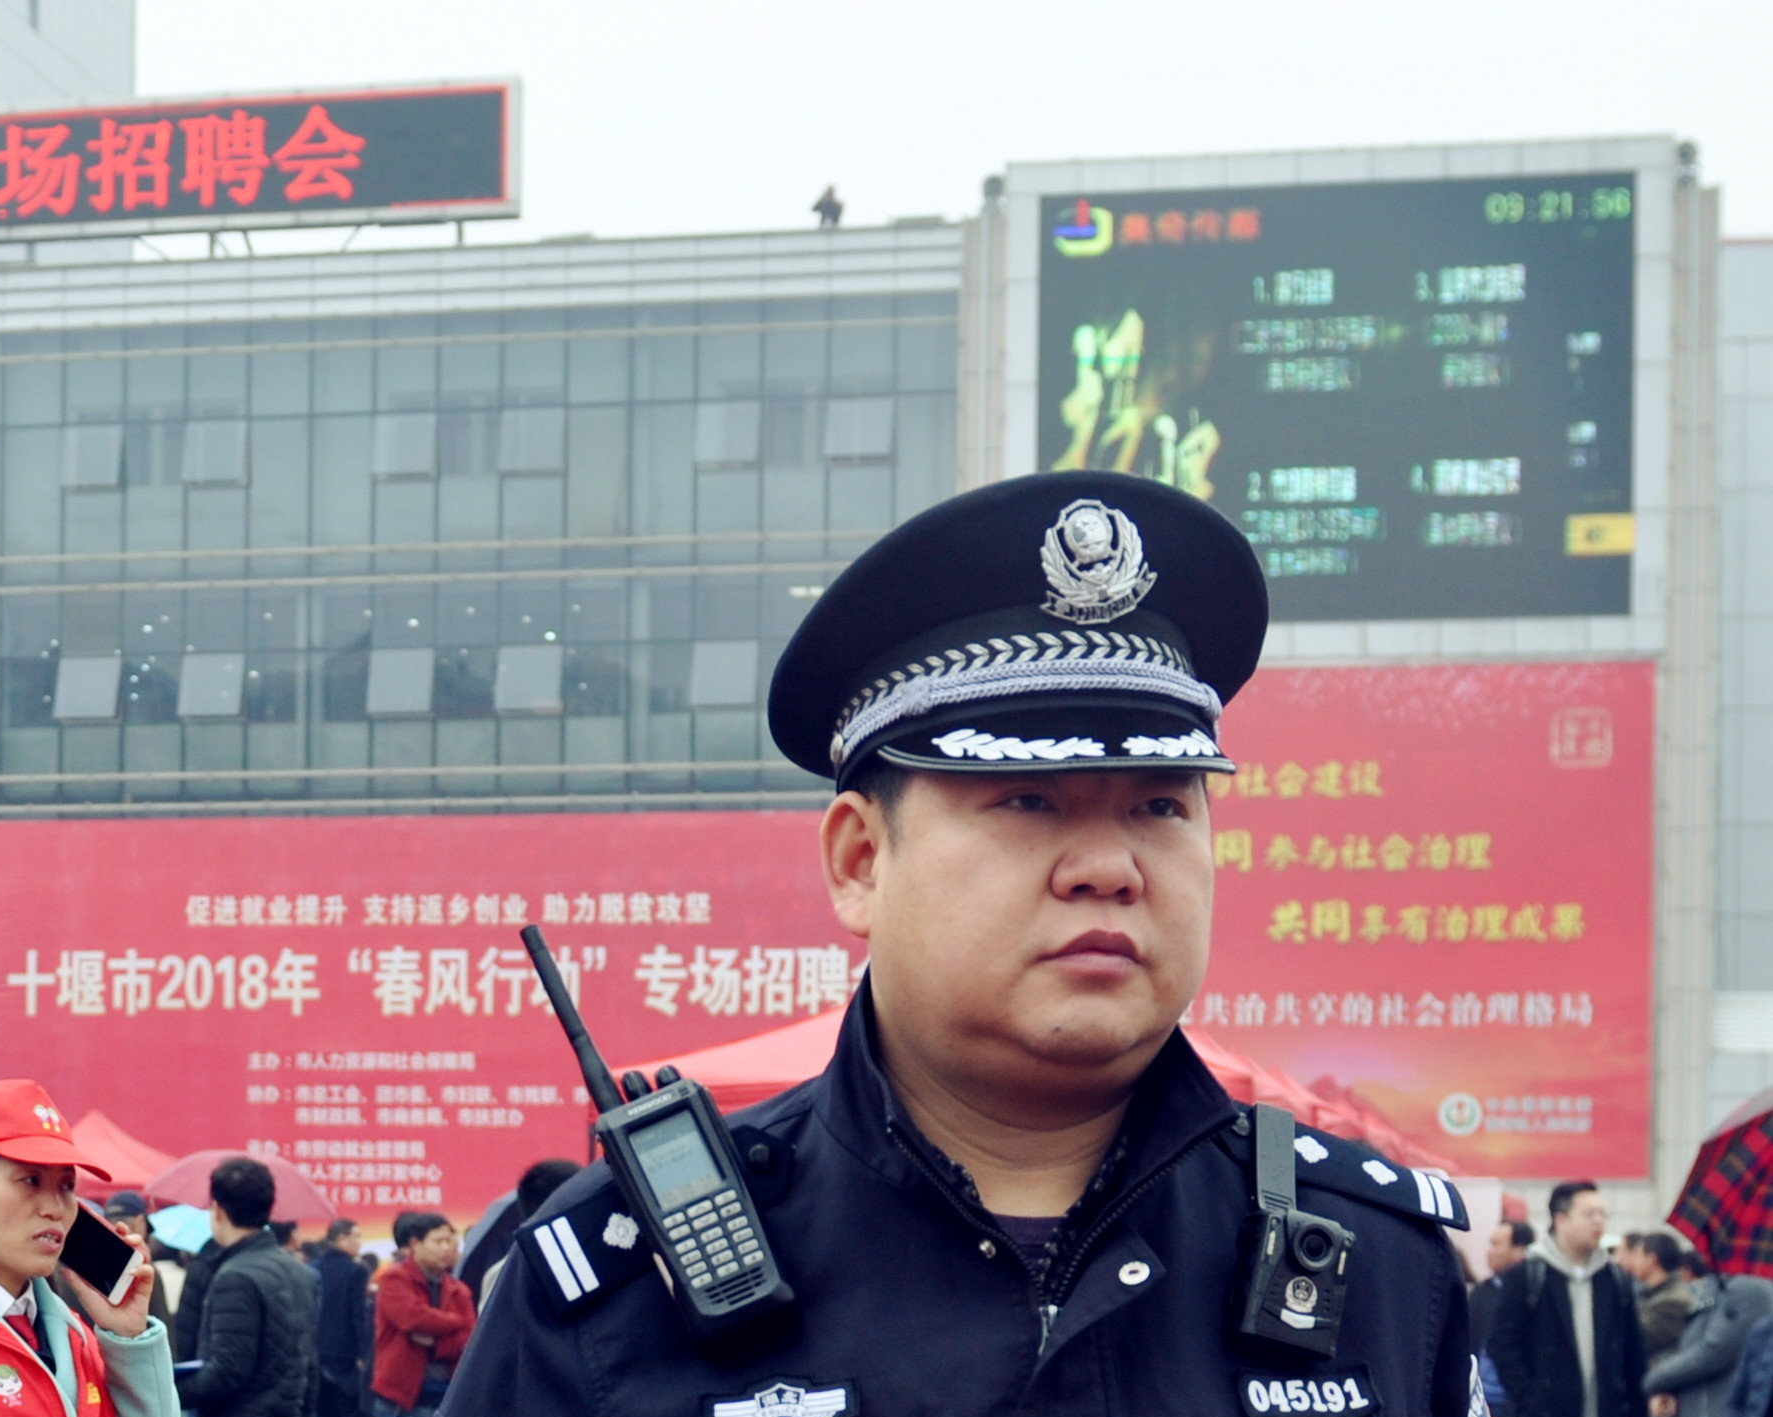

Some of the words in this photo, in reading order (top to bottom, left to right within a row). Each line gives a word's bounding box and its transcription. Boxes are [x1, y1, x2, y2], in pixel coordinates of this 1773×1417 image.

[185, 894, 348, 927] 促进就业提升
[364, 893, 528, 926] 支持返乡创业
[543, 891, 712, 925] 助力脱贫攻坚
[1267, 900, 1586, 944] 共同享有治理成果
[1247, 1377, 1369, 1413] 045191
